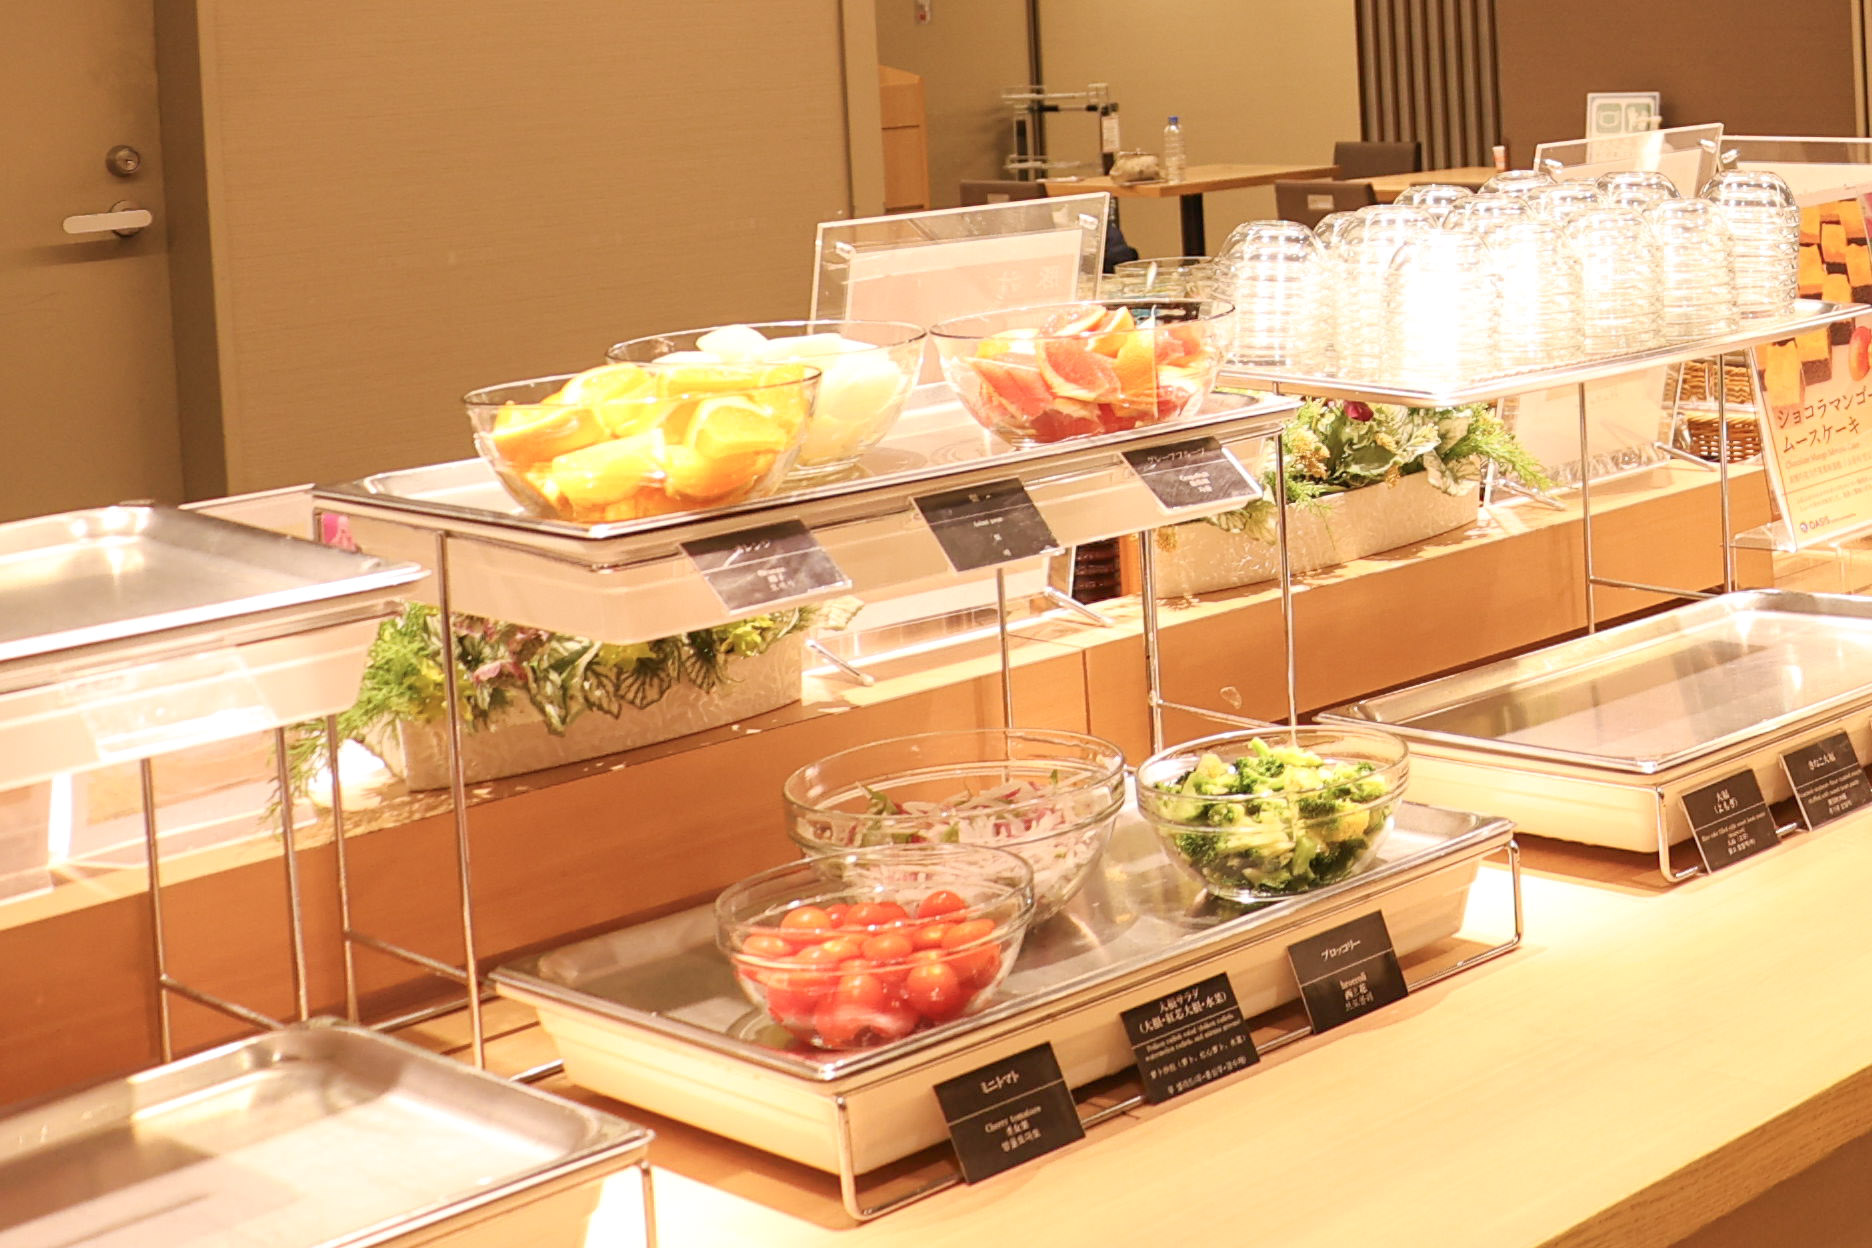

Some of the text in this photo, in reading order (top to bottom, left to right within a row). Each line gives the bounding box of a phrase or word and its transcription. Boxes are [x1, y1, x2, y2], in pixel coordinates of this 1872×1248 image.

[1783, 416, 1860, 454] ムースケーキ
[1320, 938, 1361, 962] ブロッコリー
[981, 1070, 1020, 1094] ミニトマト
